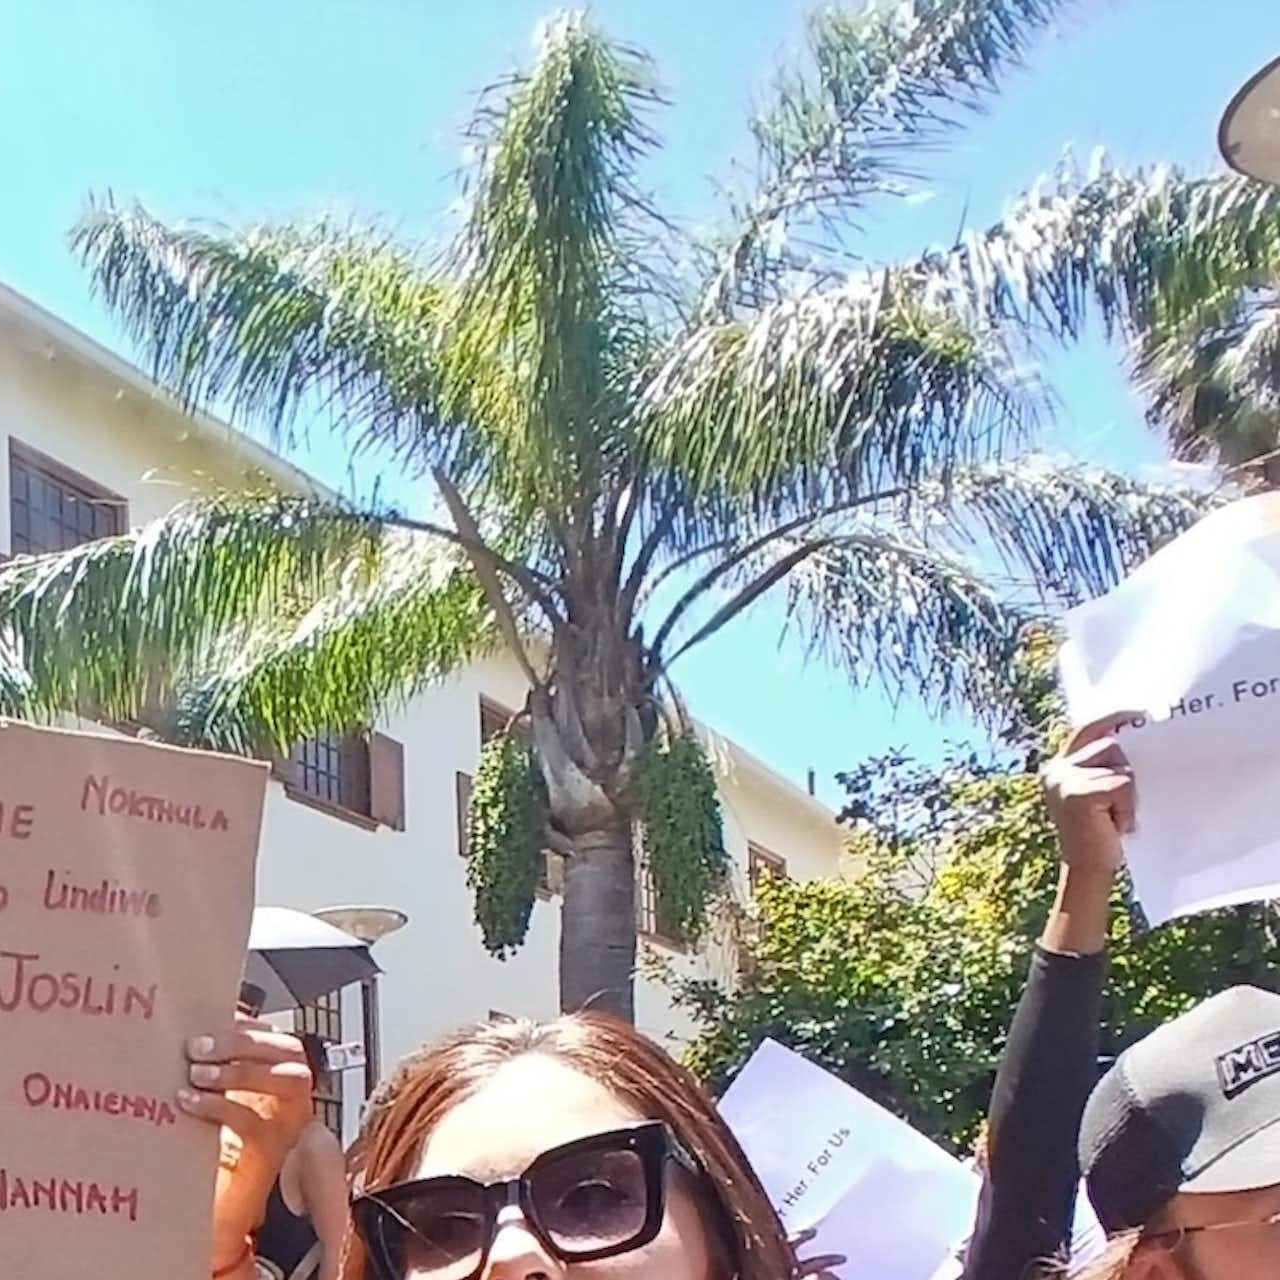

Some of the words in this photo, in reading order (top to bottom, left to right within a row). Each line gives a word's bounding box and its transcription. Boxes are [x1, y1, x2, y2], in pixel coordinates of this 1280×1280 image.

[1232, 678, 1280, 702] For
[807, 1149, 832, 1175] For
[827, 1128, 850, 1148] Us
